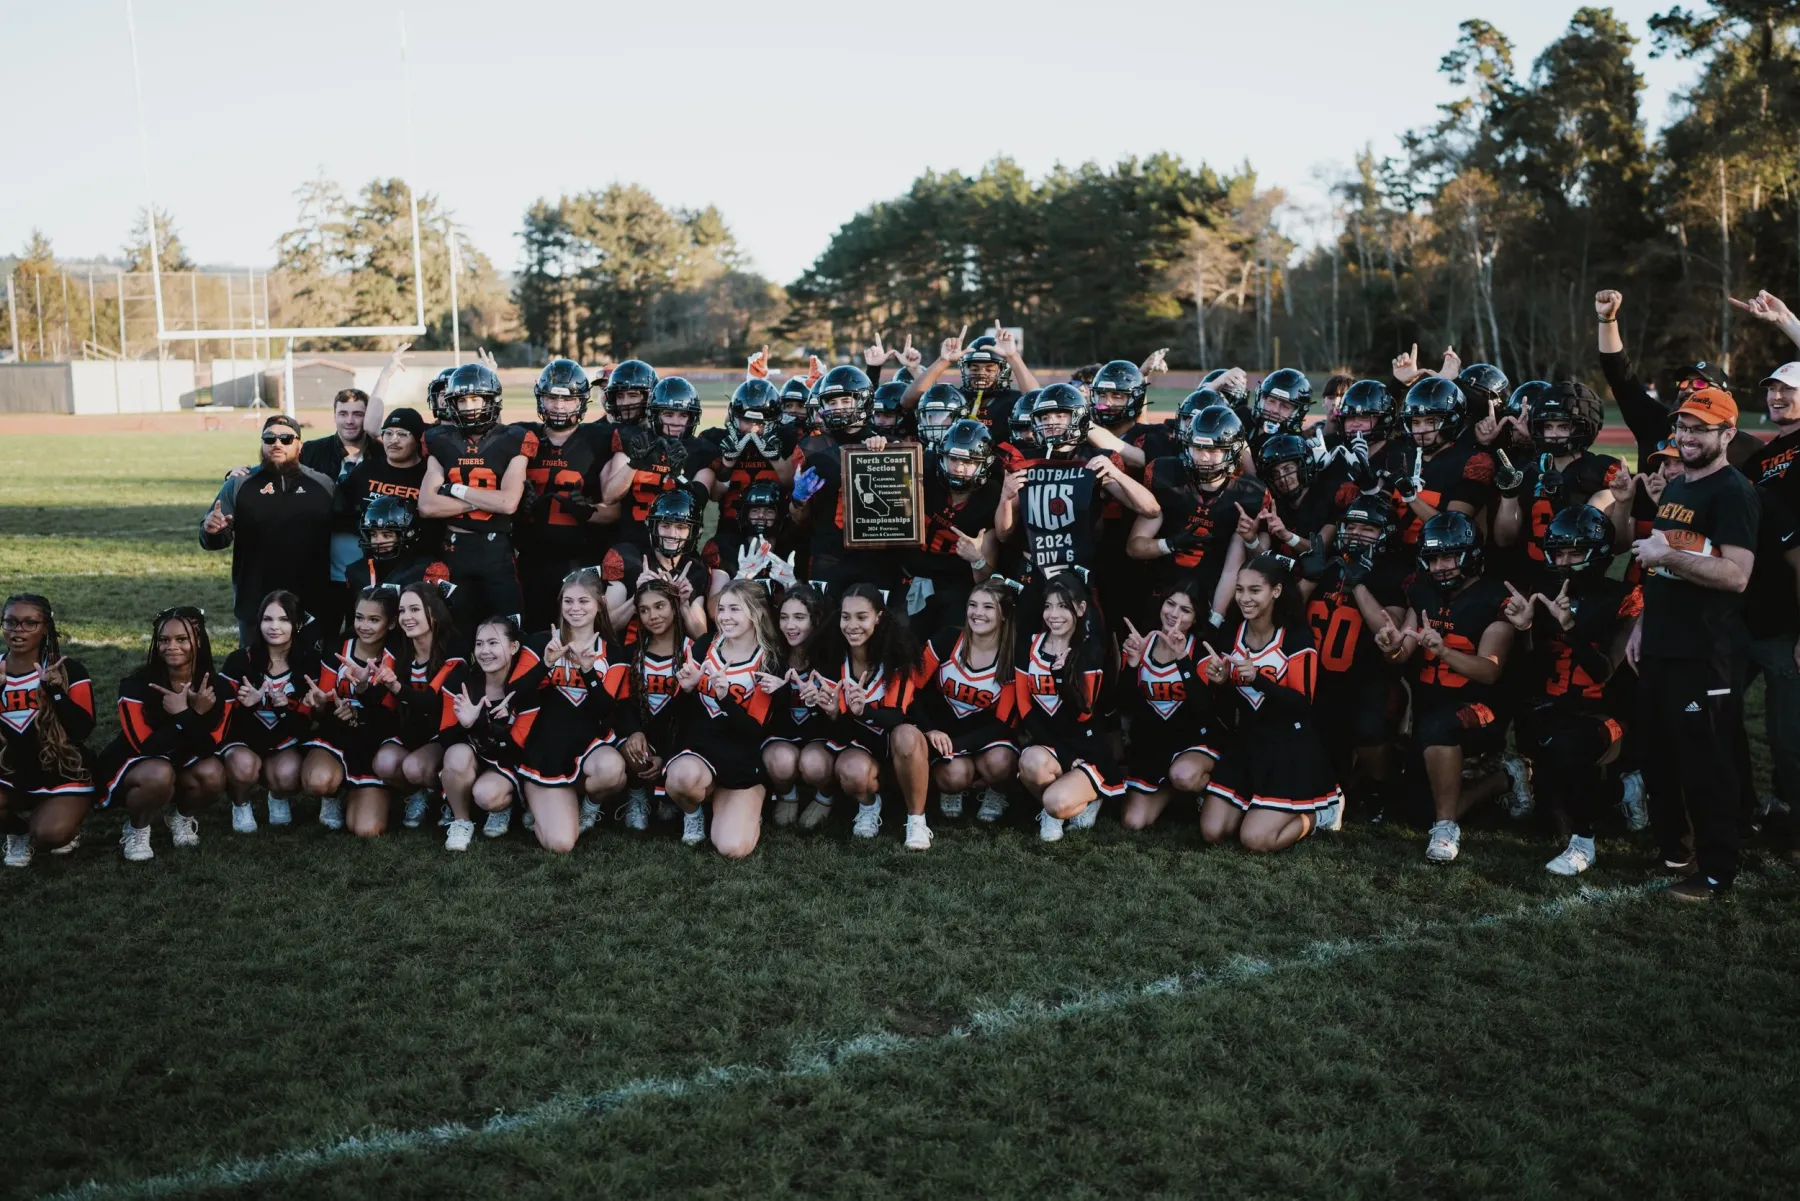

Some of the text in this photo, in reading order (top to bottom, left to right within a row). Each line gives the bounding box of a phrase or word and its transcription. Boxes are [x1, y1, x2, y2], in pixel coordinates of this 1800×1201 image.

[542, 459, 568, 467] TIGERS
[883, 456, 907, 464] Coast
[1028, 467, 1085, 481] OOTBALL
[368, 480, 421, 499] TIGER
[1027, 484, 1076, 531] NCS
[855, 516, 911, 525] Championships
[1035, 533, 1073, 550] 2024
[1036, 549, 1075, 566] DIV 6
[1428, 620, 1455, 630] TIGRS
[1307, 600, 1363, 672] 60
[645, 673, 681, 695] HS
[1028, 673, 1057, 695] AH
[1231, 664, 1278, 687] AS
[697, 672, 748, 706] AS
[942, 676, 995, 710] AHS
[0, 688, 40, 712] HS
